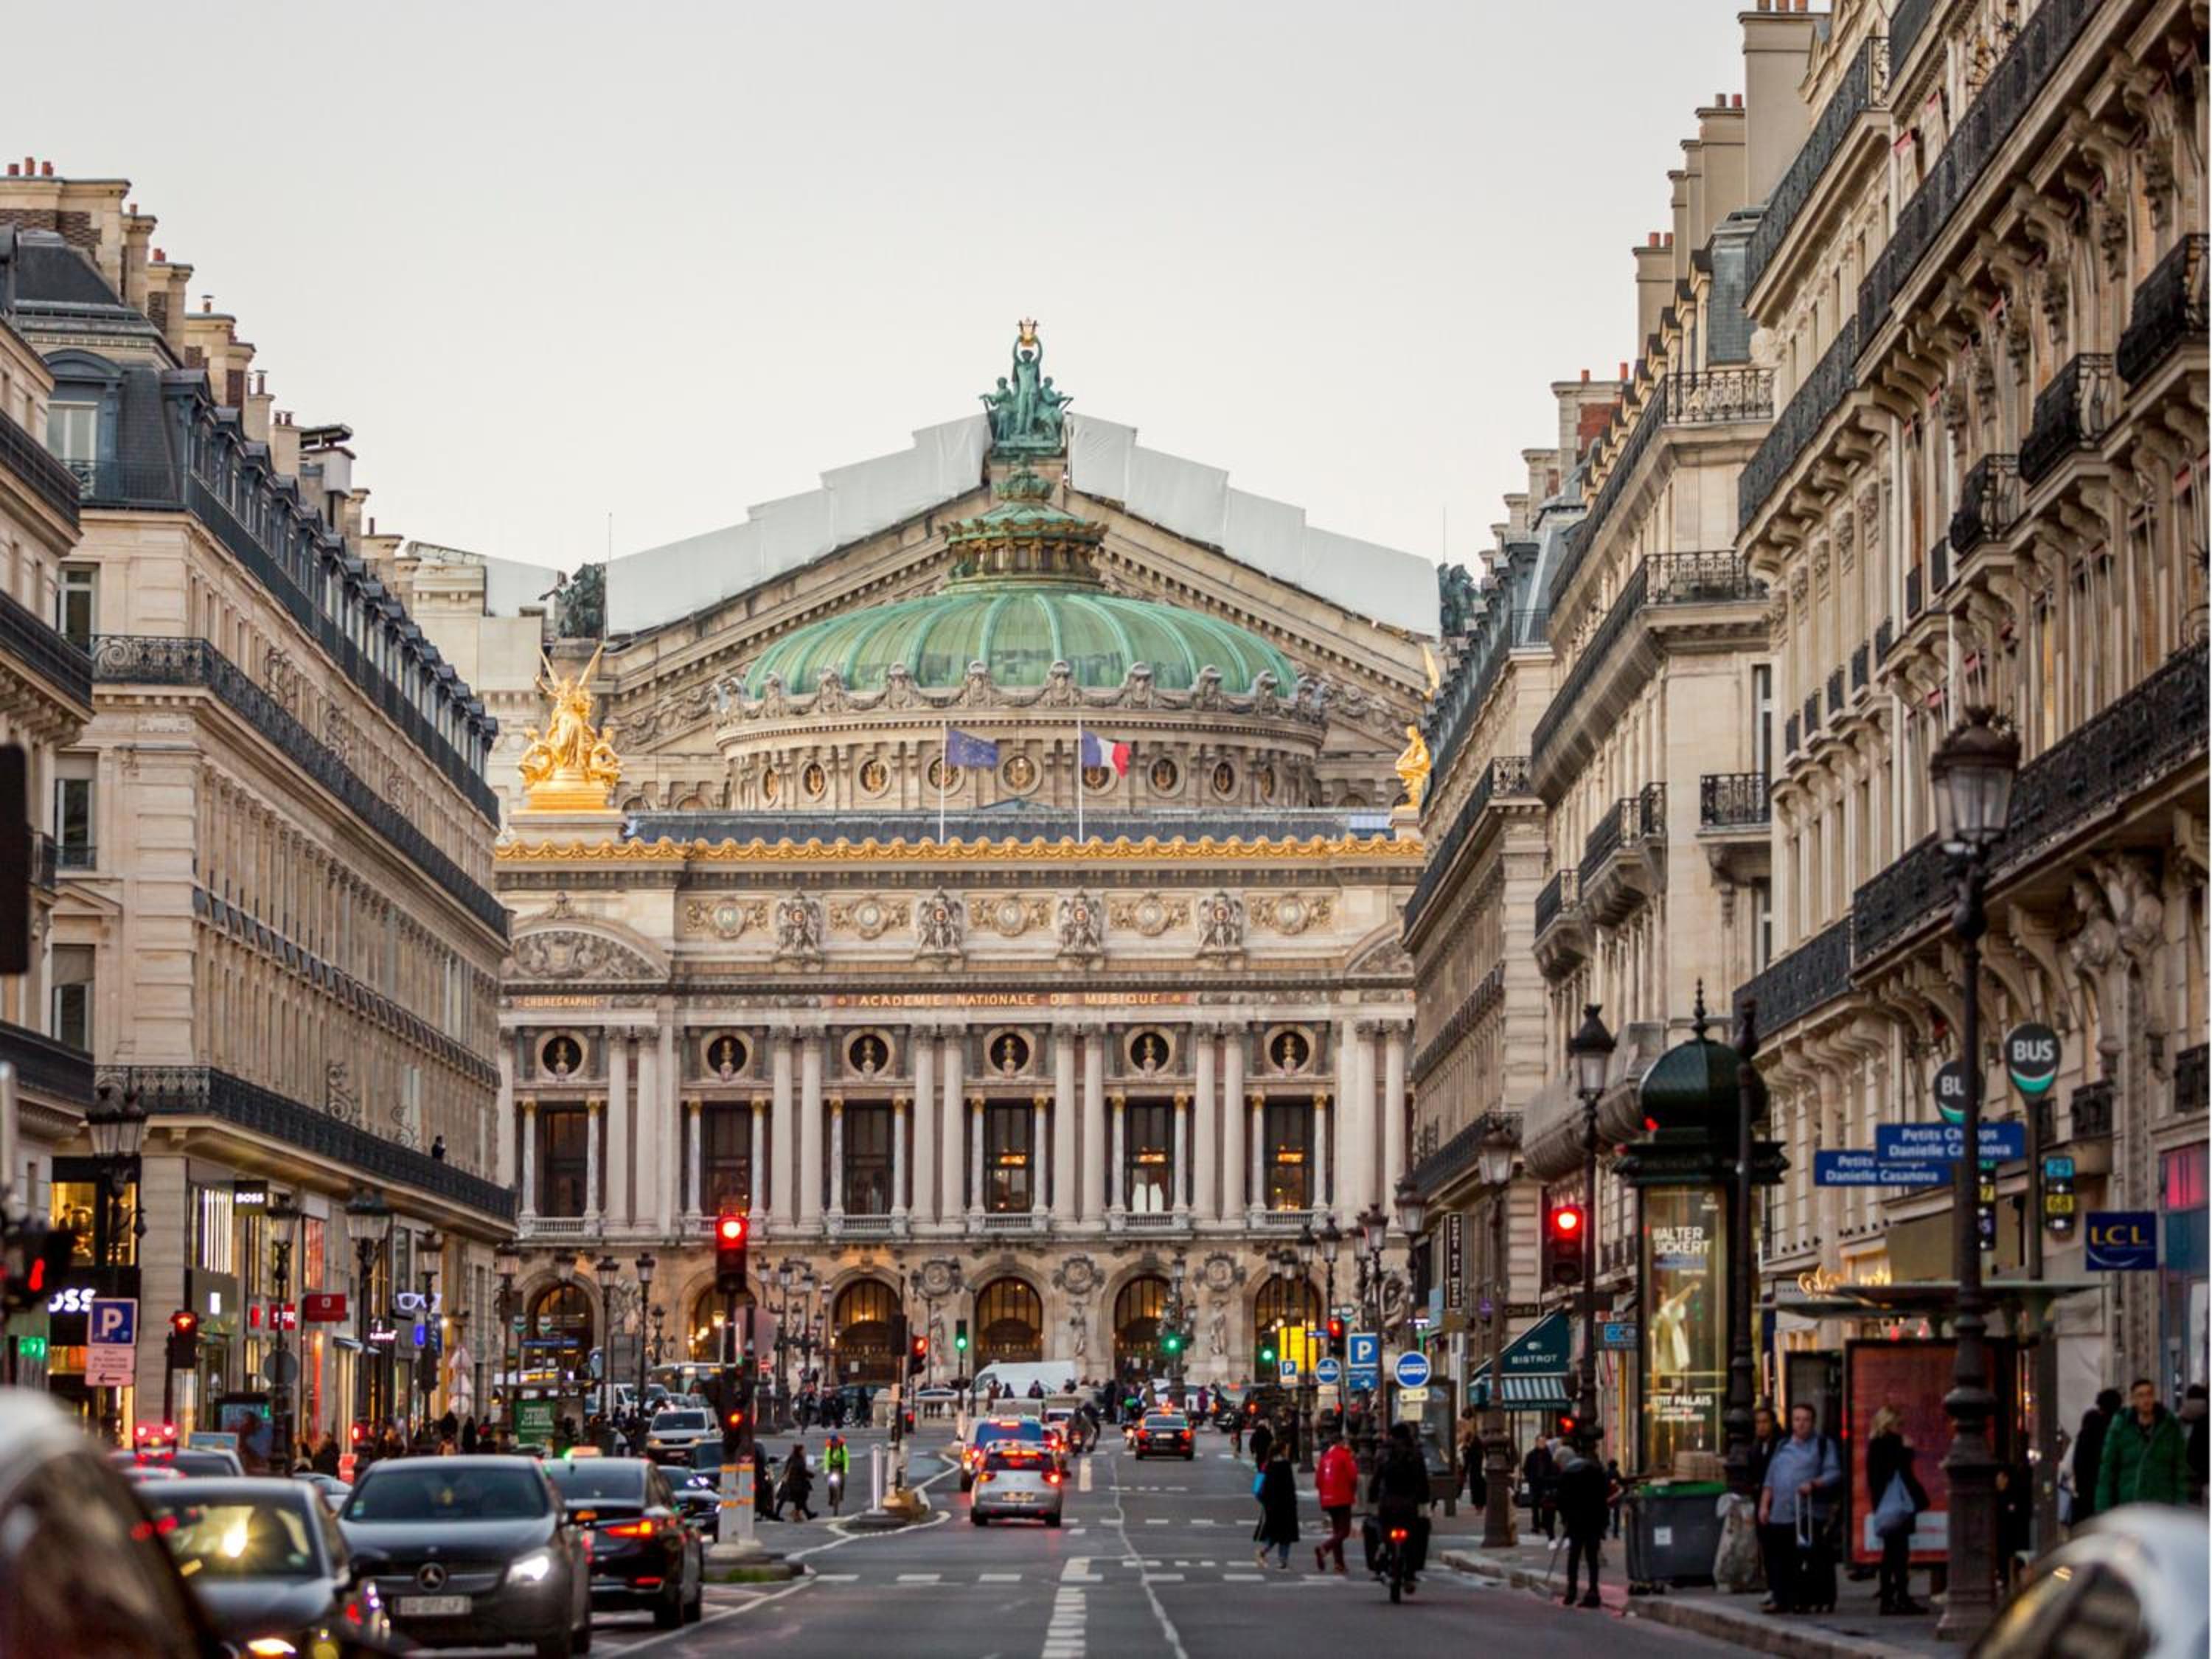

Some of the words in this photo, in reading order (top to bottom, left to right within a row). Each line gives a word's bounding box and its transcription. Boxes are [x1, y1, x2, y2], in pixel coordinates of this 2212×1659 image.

[859, 995, 943, 1006] ACADEMIE
[956, 994, 1037, 1006] NATIONALE
[1050, 994, 1071, 1005] DE
[1085, 993, 1160, 1005] MUSIQUE
[2012, 1040, 2054, 1062] BUS
[1941, 1076, 1965, 1096] BU
[1902, 1128, 1941, 1142] Petits
[1888, 1144, 1944, 1157] Danielle
[1948, 1144, 2011, 1157] Canova
[1837, 1156, 1874, 1167] Petits
[1825, 1169, 1877, 1182] Danielle
[1879, 1170, 1938, 1183] Casanova
[235, 1192, 264, 1203] BOSS
[1651, 1226, 1704, 1241] WALTER
[2090, 1225, 2149, 1245] LCL
[102, 1308, 123, 1337] P
[1357, 1341, 1372, 1360] P
[1512, 1354, 1558, 1365] BISTROT
[1674, 1395, 1712, 1406] PALAIS
